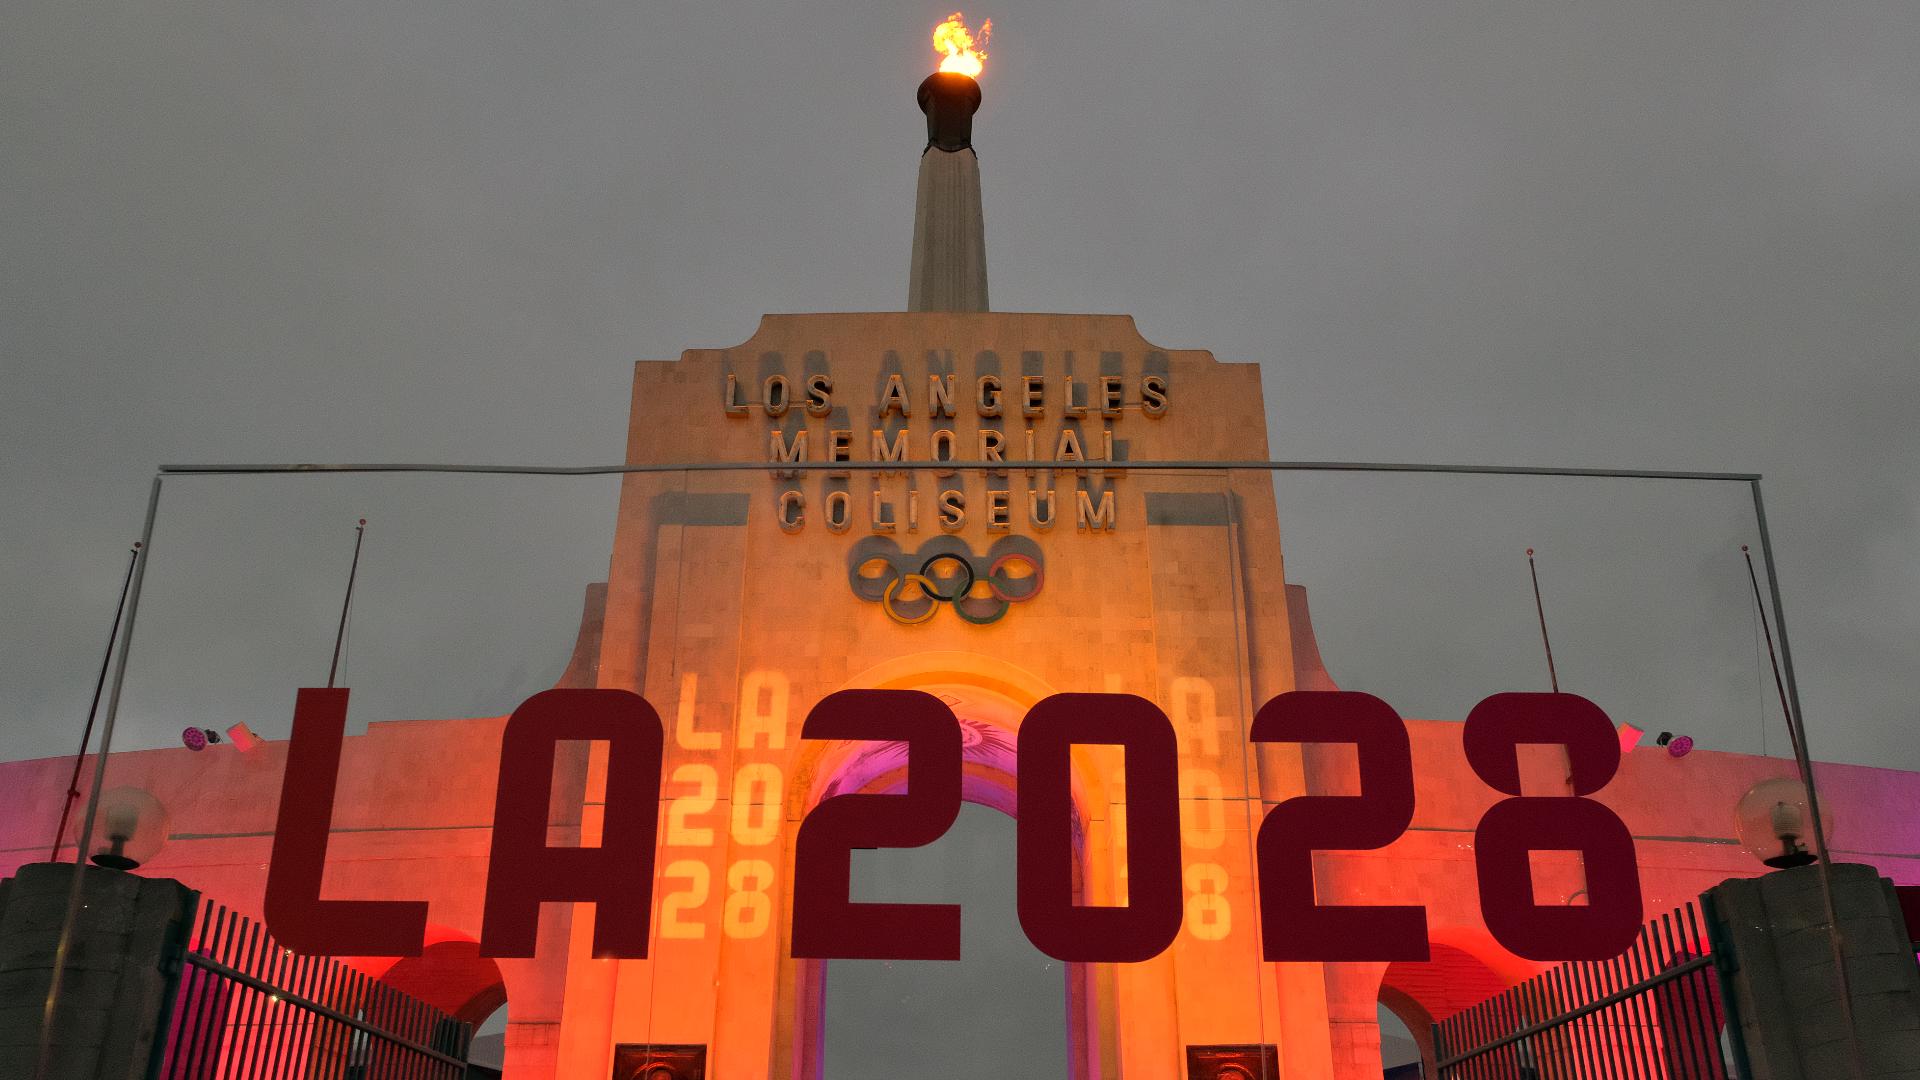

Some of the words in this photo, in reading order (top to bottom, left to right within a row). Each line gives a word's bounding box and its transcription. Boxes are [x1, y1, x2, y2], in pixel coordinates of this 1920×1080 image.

[725, 373, 833, 418] LOS
[878, 373, 1169, 418] ANGELES
[769, 429, 1127, 479] MEMORIAL
[777, 489, 1117, 534] COLISEUM
[676, 671, 789, 750] LA
[264, 687, 664, 960] LA
[790, 688, 1644, 964] 2028
[667, 763, 783, 846] 20
[660, 860, 774, 940] 28
